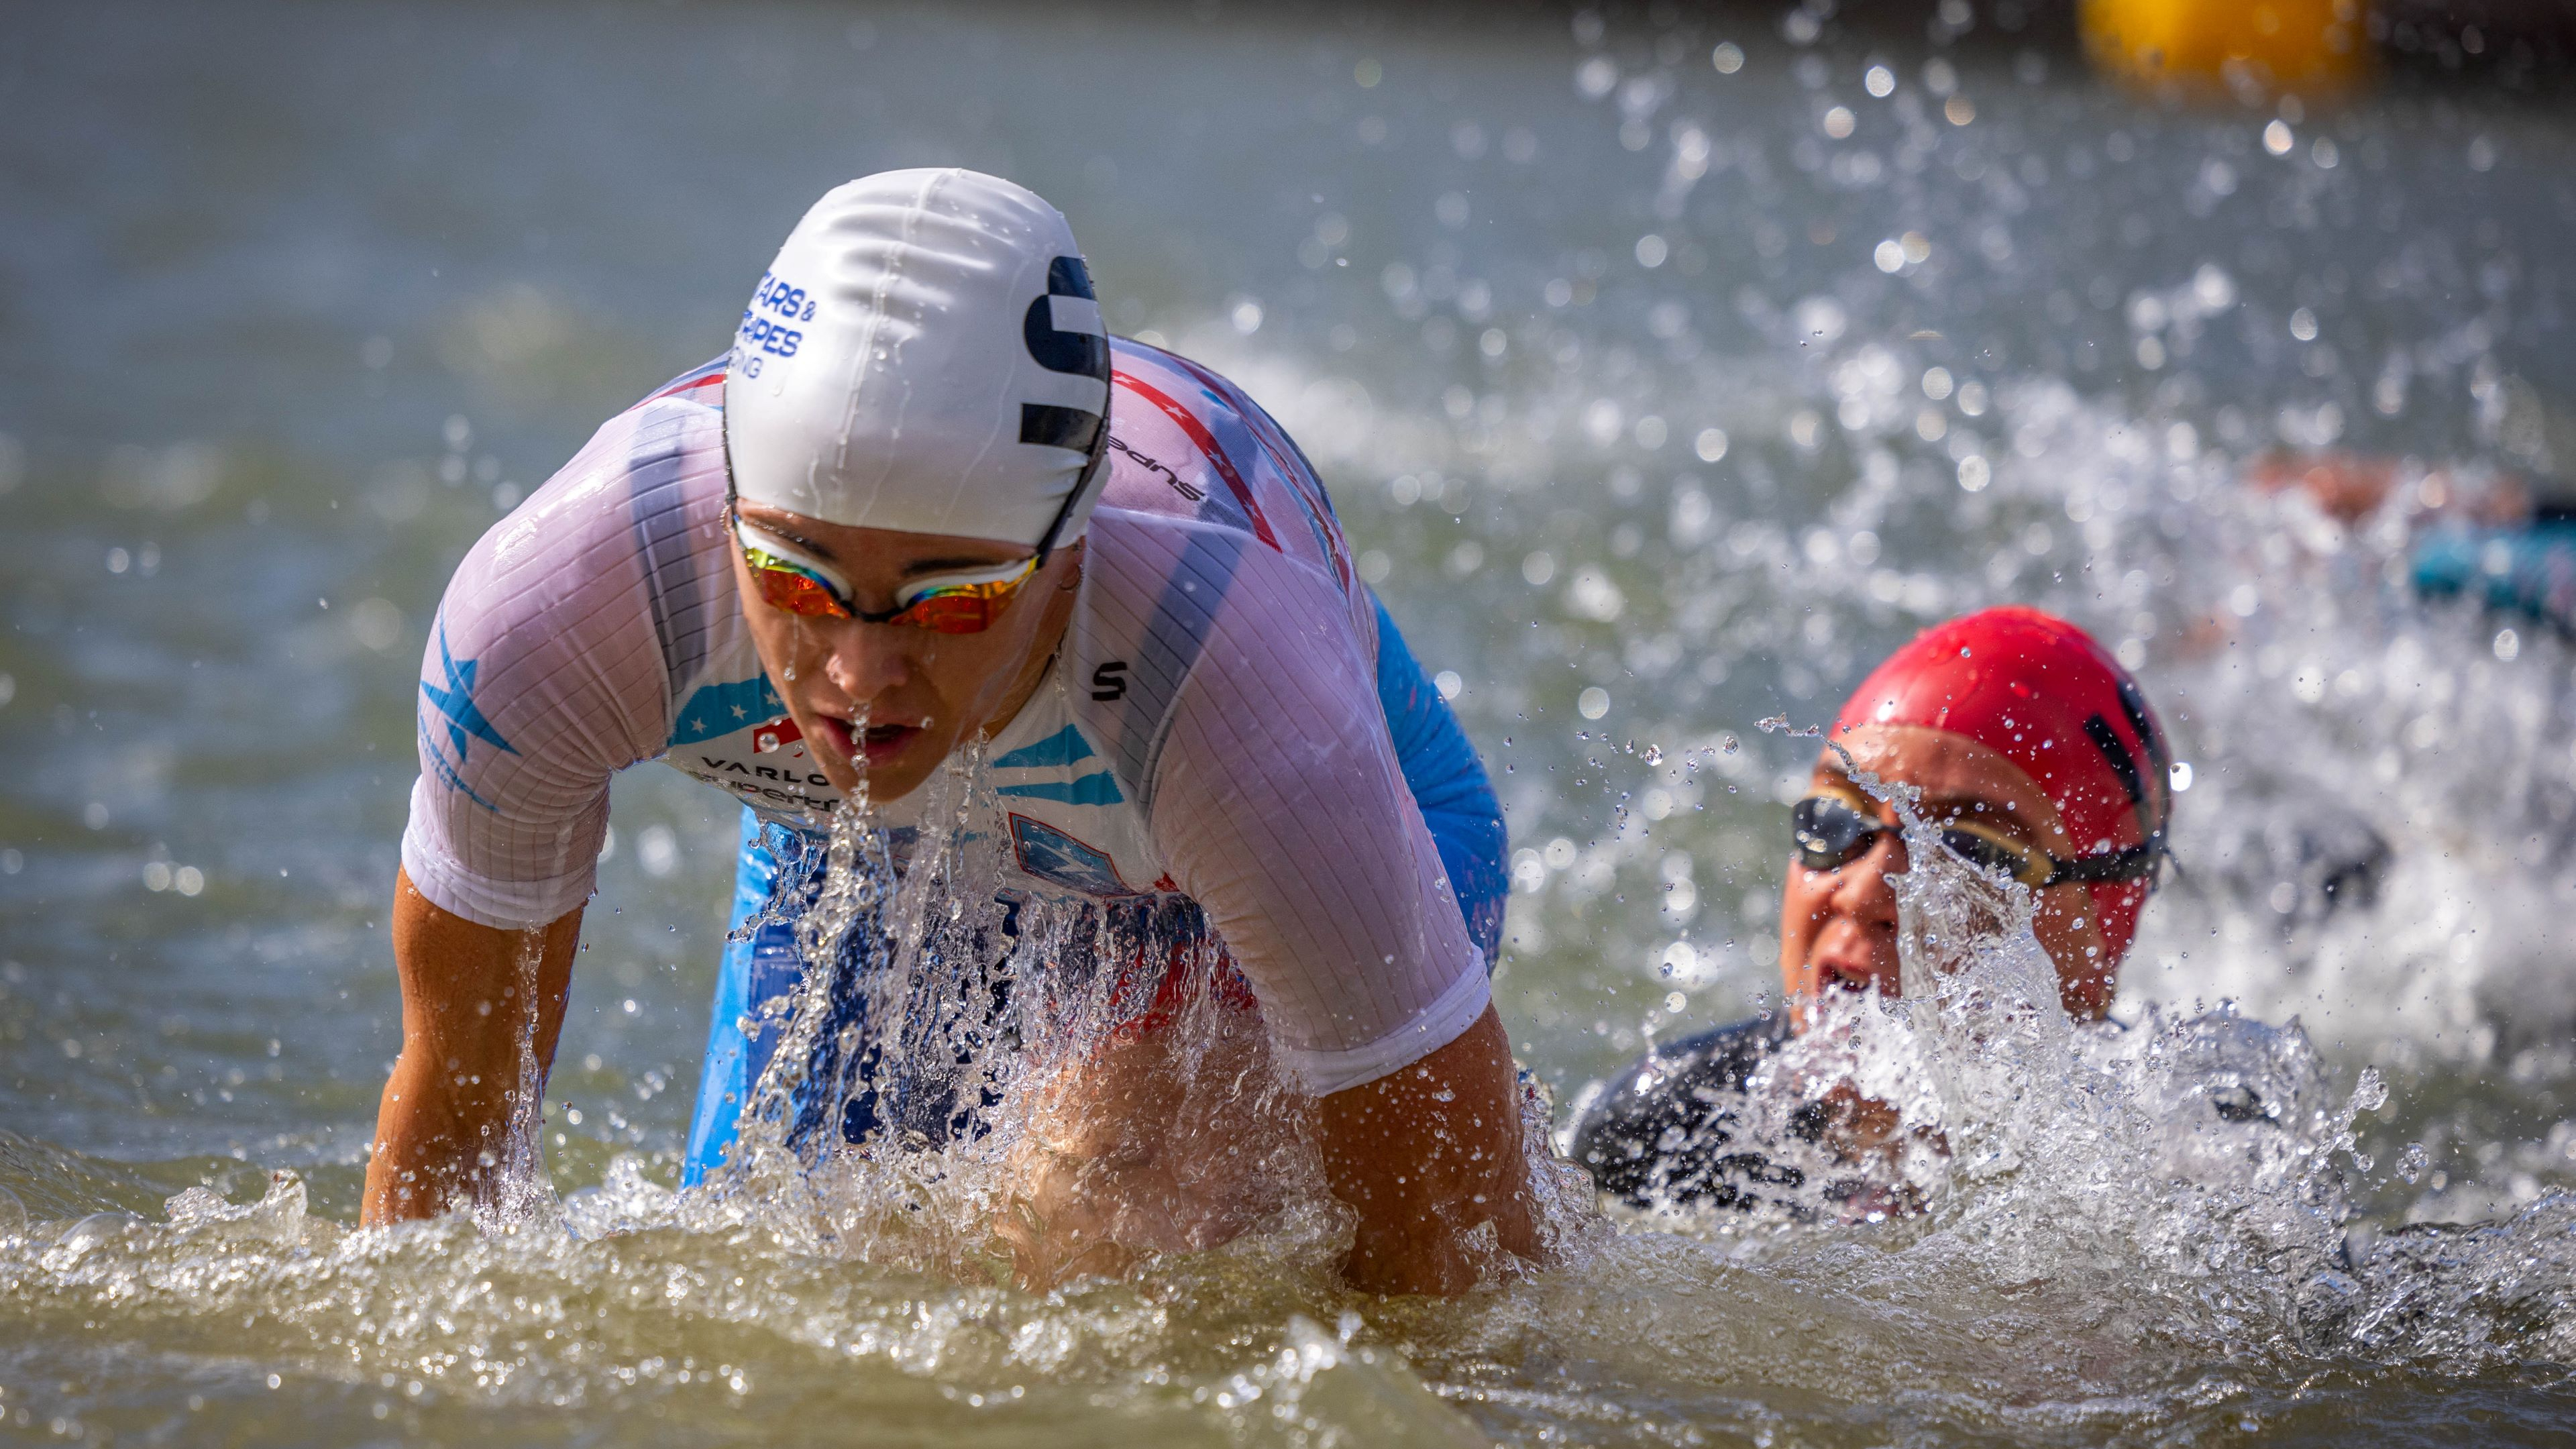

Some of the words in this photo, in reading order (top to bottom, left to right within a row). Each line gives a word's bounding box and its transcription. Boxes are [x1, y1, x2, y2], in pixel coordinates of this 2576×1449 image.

[758, 272, 806, 318] ARS
[1108, 434, 1205, 502] supe
[701, 756, 830, 787] VARLO
